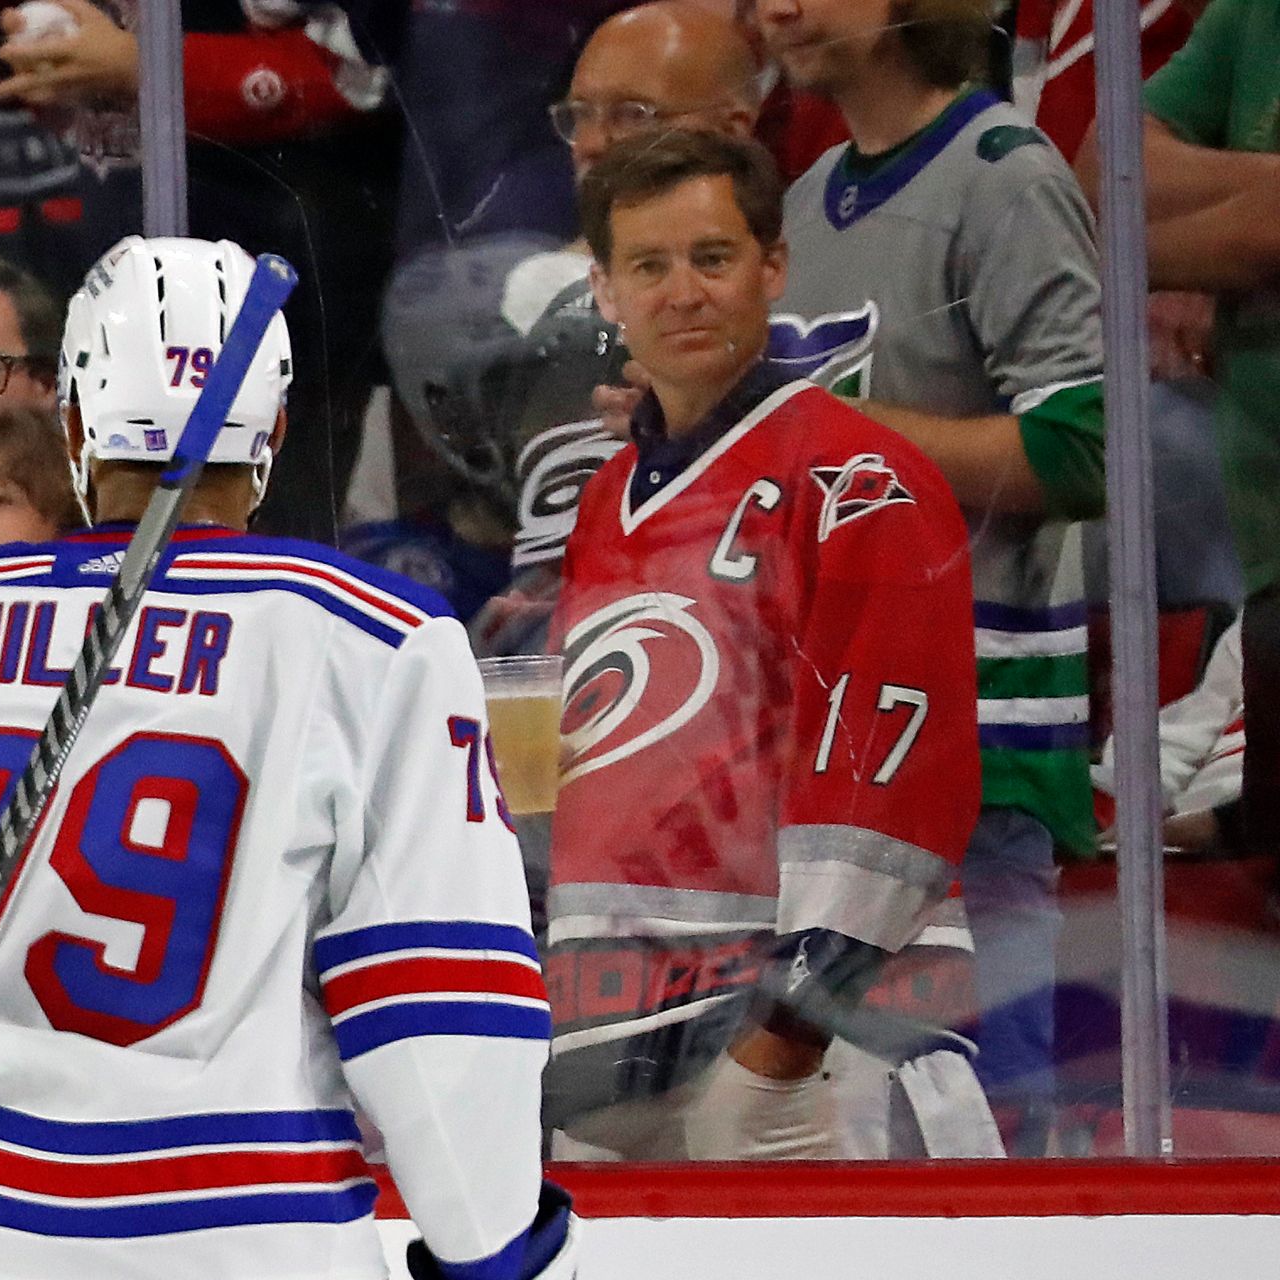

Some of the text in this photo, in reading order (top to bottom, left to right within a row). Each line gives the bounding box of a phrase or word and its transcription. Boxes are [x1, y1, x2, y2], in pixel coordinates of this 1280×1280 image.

[166, 346, 216, 389] 79
[710, 477, 783, 582] C
[446, 714, 518, 835] 7
[813, 672, 930, 787] 17
